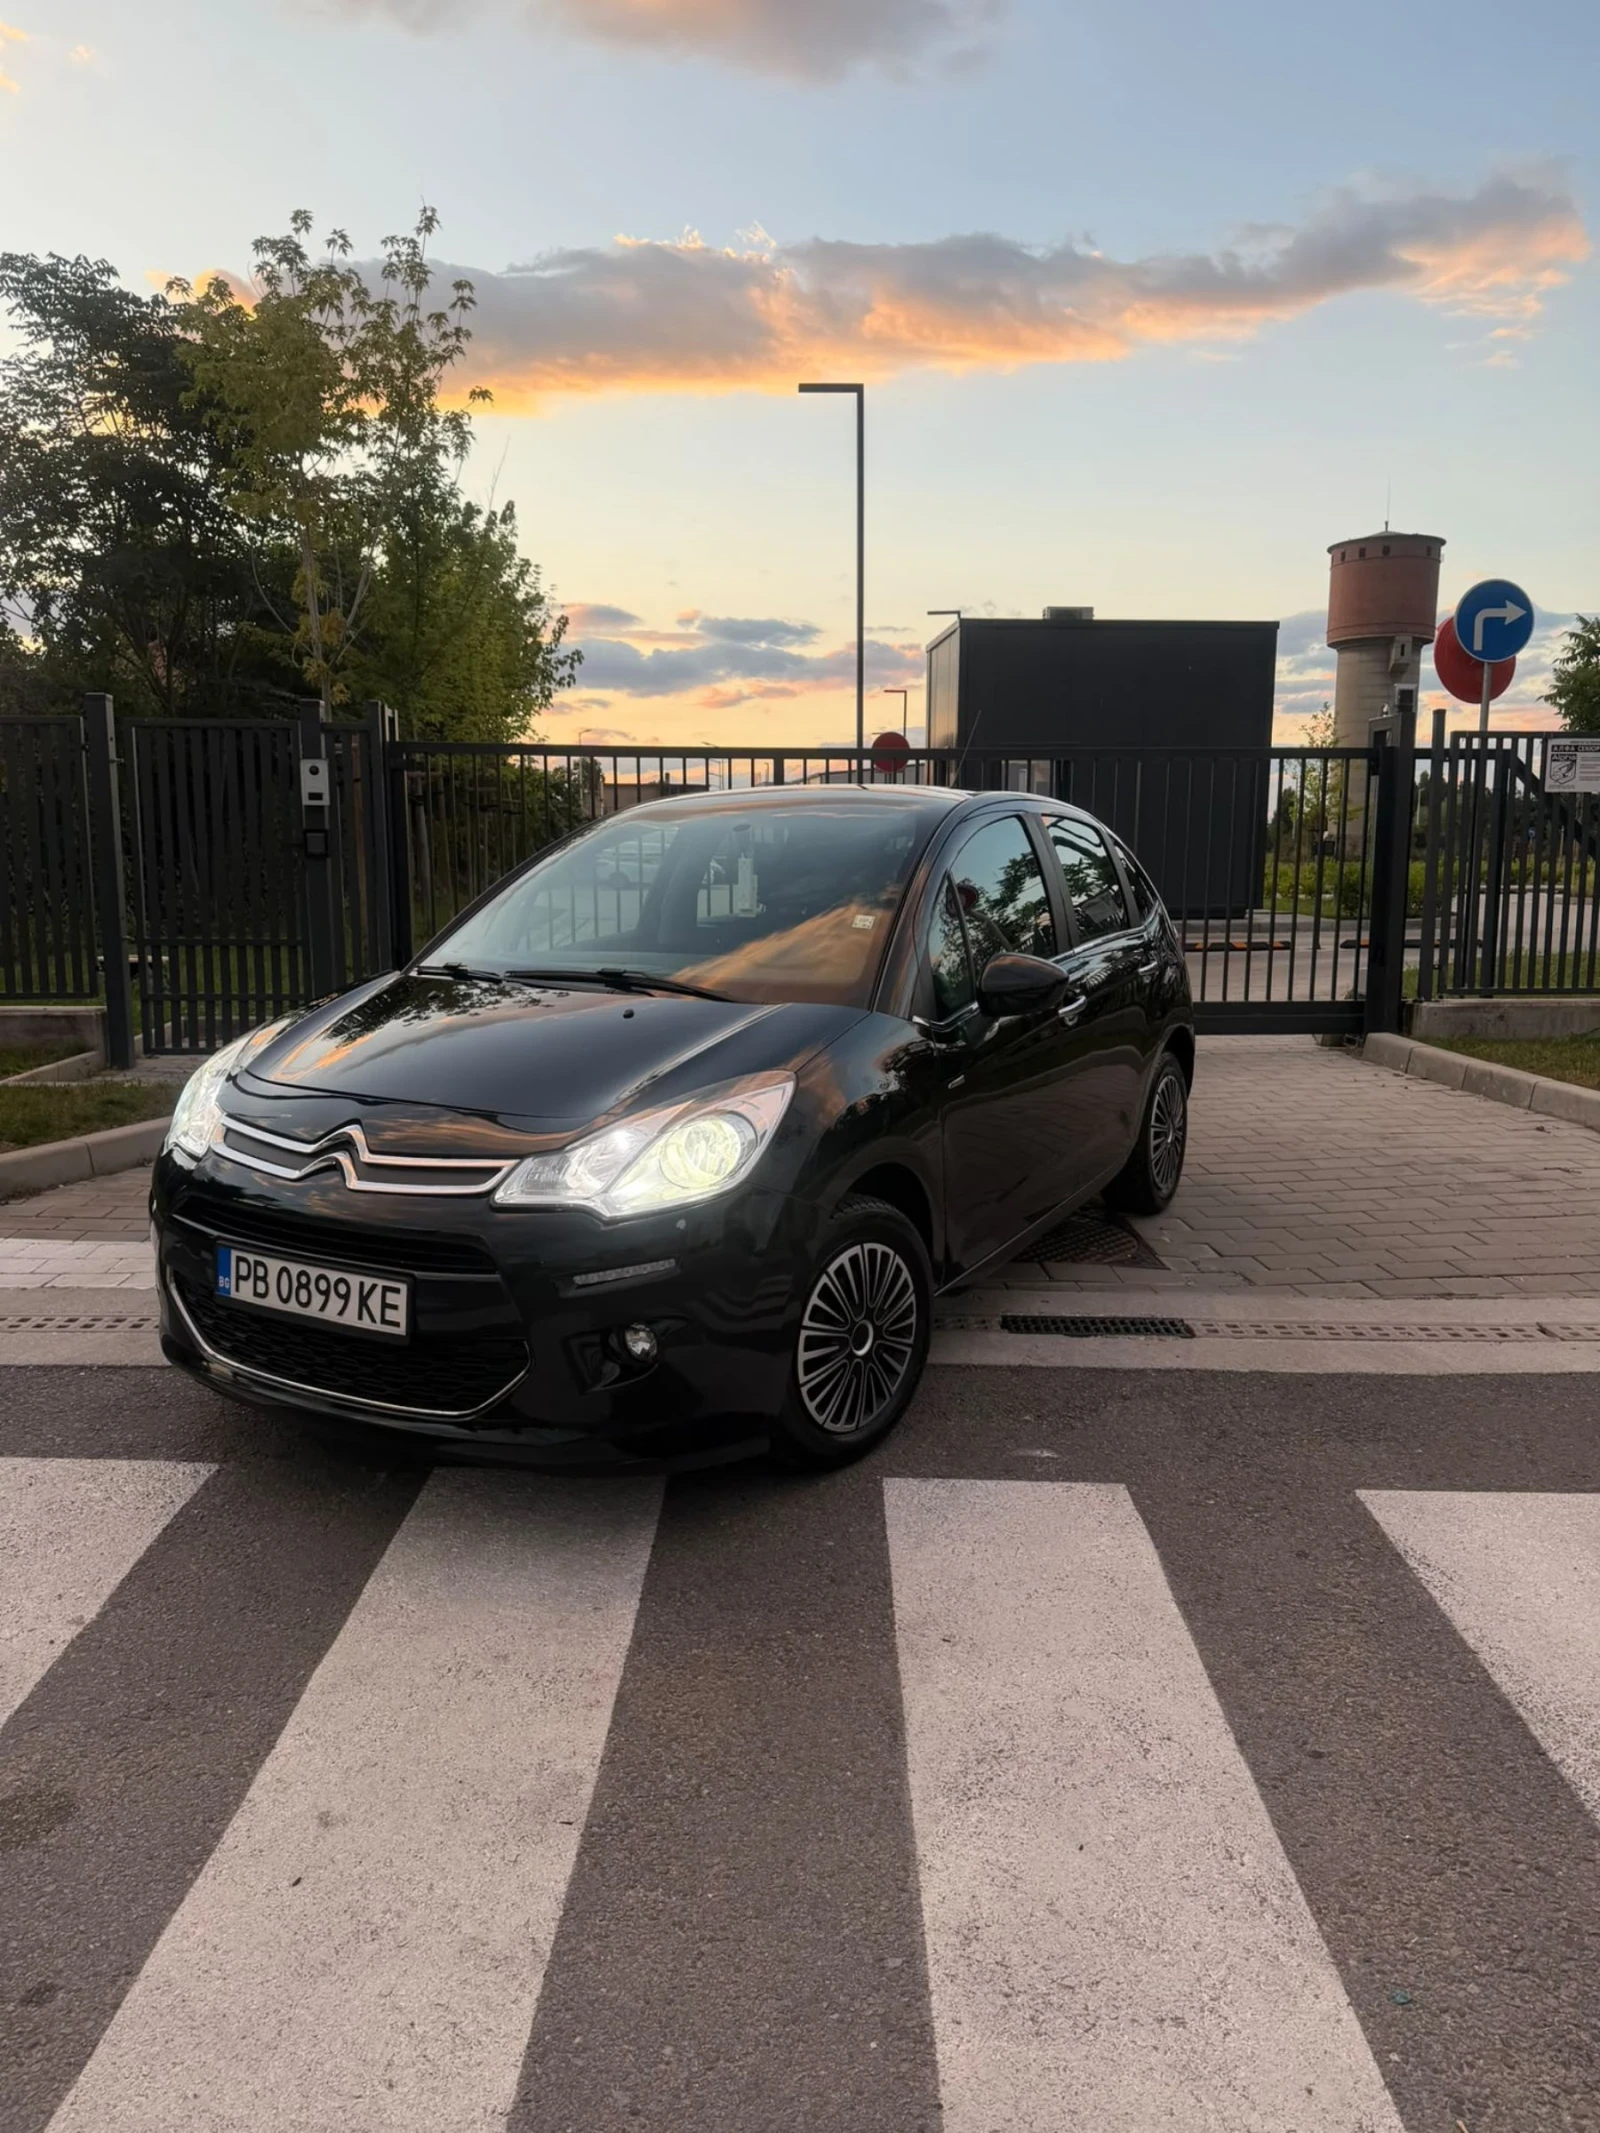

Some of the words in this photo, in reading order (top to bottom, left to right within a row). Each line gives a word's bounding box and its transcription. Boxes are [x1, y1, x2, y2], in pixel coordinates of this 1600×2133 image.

[218, 1275, 231, 1289] BG
[235, 1255, 270, 1300] PB
[276, 1265, 351, 1317] 0899
[357, 1280, 402, 1328] KE
